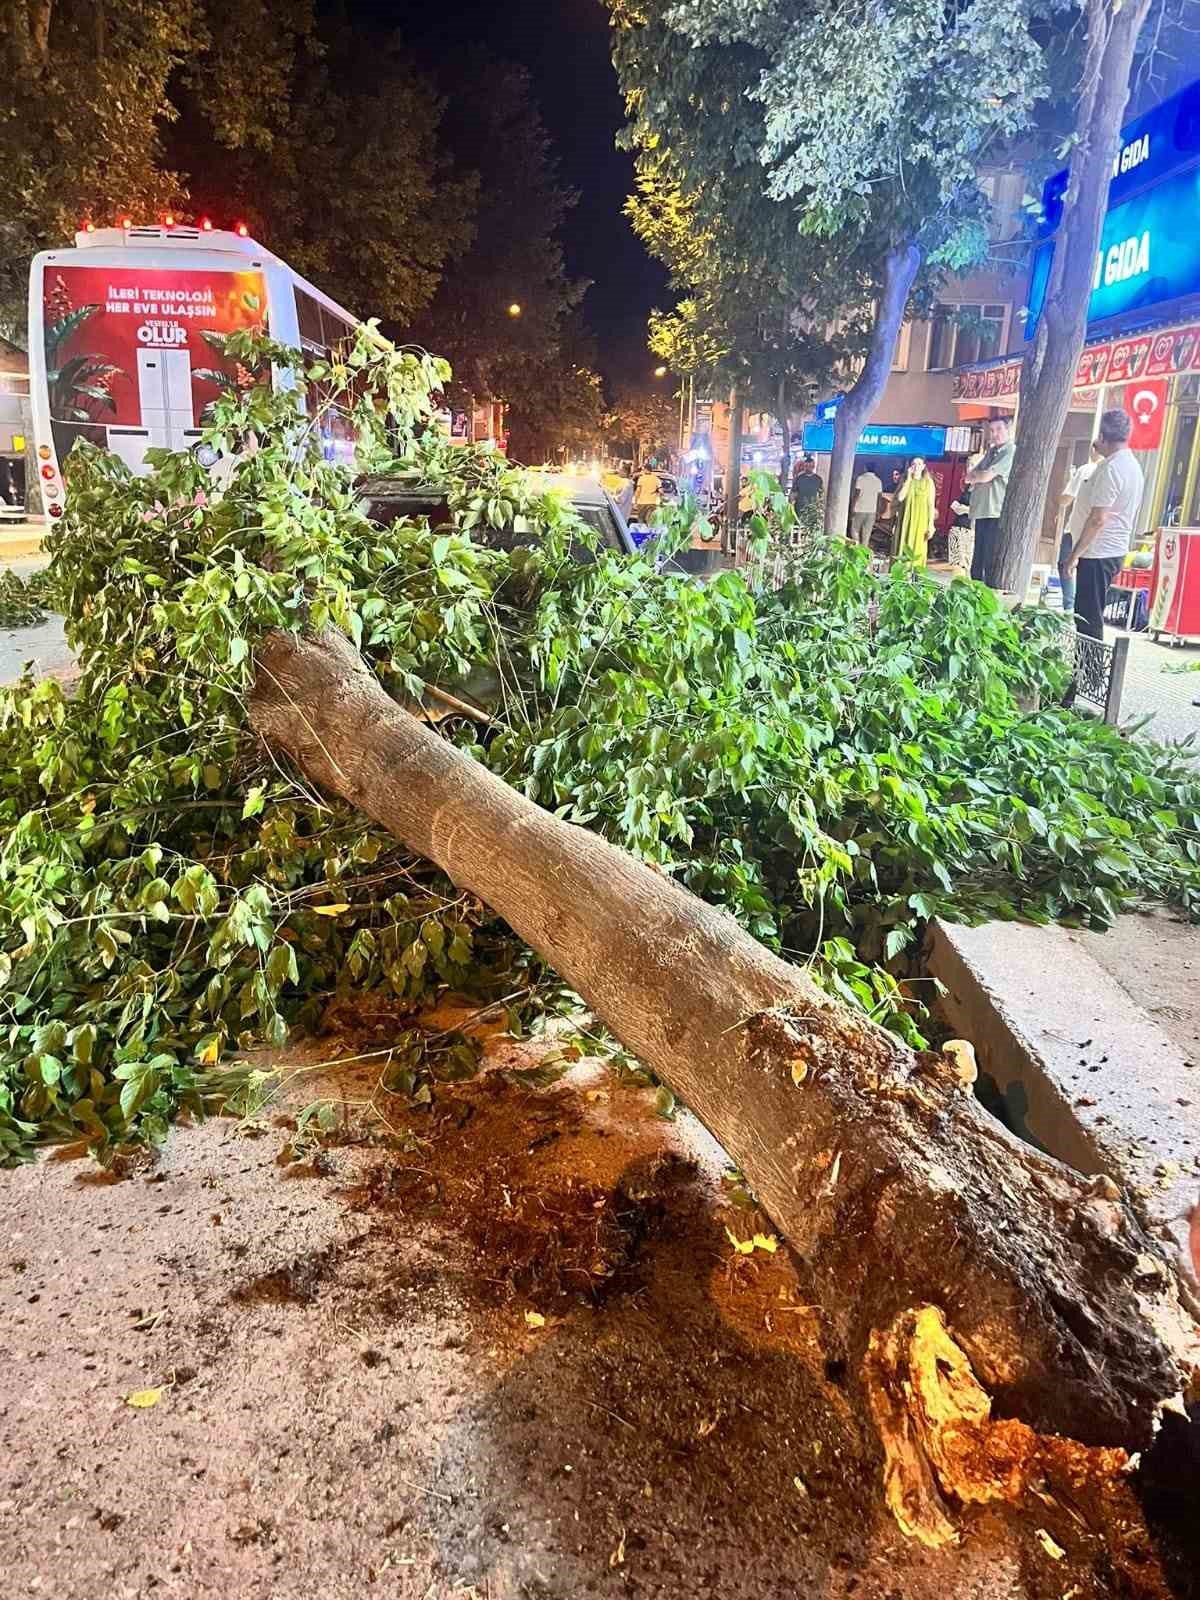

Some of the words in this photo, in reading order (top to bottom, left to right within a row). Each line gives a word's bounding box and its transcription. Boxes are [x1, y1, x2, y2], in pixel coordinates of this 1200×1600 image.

[1120, 133, 1150, 173] GIDA
[1104, 231, 1150, 286] GIDA
[108, 285, 139, 300] İLERİ
[143, 288, 214, 302] TEKNOLOJİ
[106, 302, 130, 313] HER
[134, 303, 158, 314] EVE
[161, 304, 217, 318] ULAŞSIN
[137, 326, 188, 343] OLUR
[880, 435, 907, 446] GIDA
